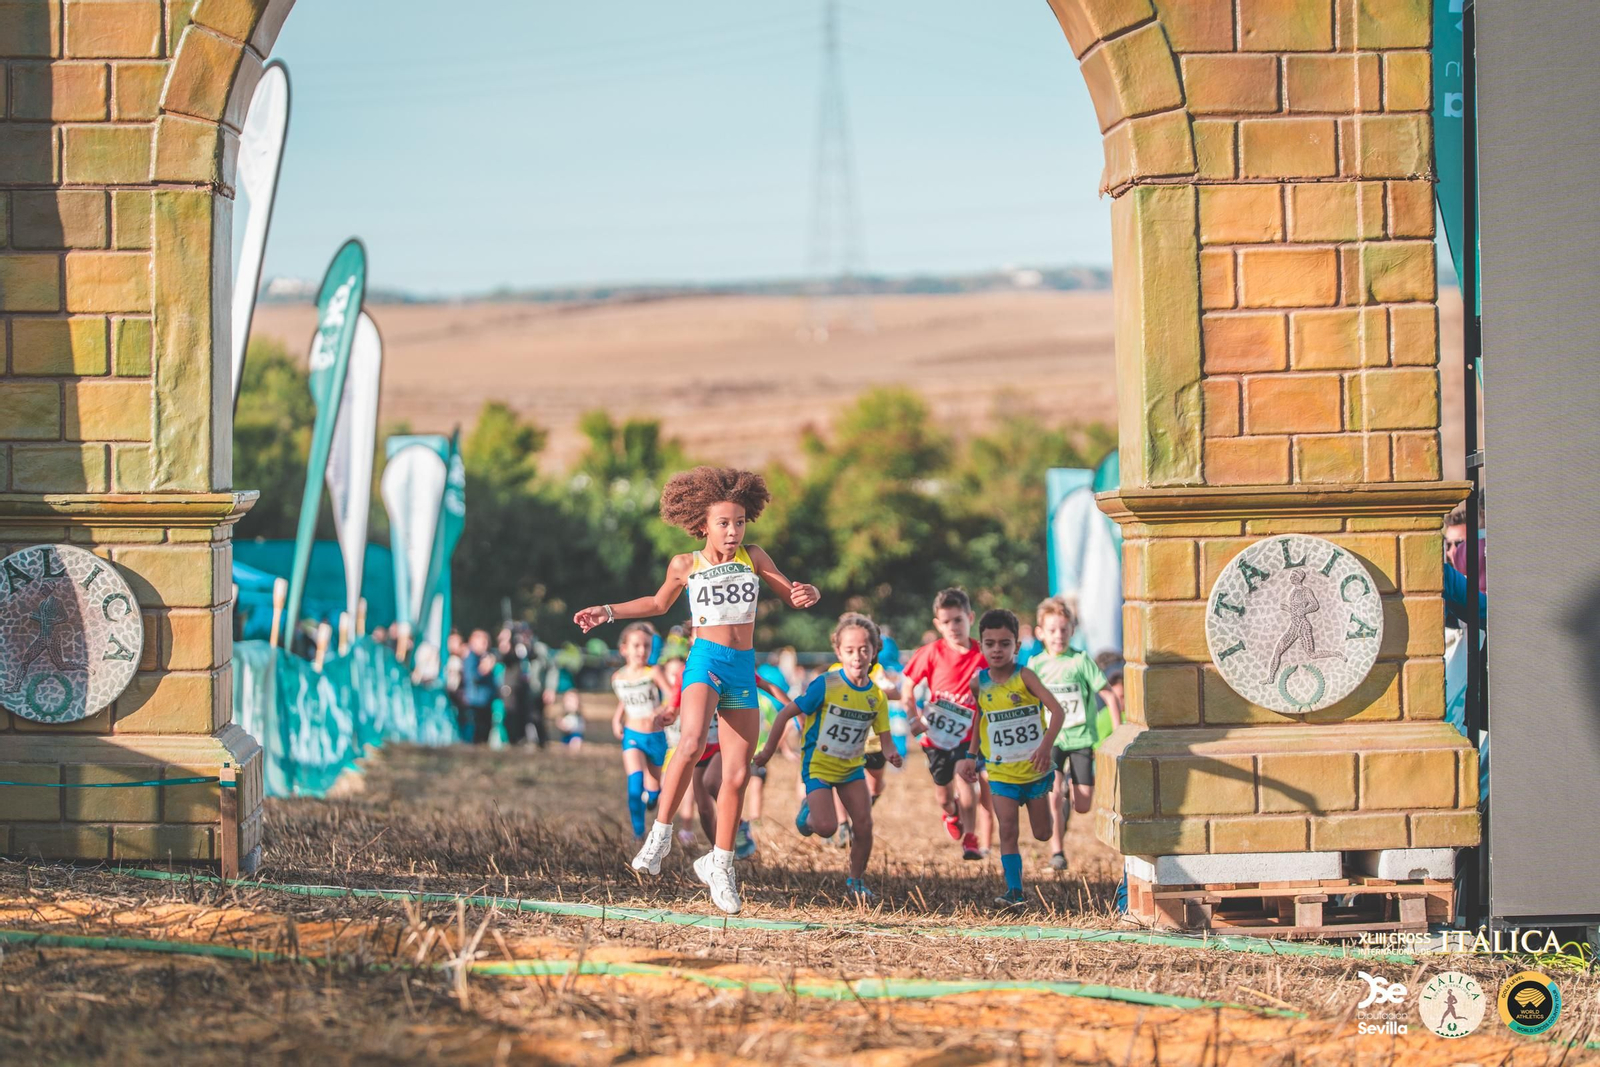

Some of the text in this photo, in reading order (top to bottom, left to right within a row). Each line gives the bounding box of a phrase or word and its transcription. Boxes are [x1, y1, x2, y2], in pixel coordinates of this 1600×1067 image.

[2, 549, 135, 663] ALICA
[696, 581, 756, 607] 4588
[927, 712, 967, 738] 4632
[993, 723, 1040, 747] 4583
